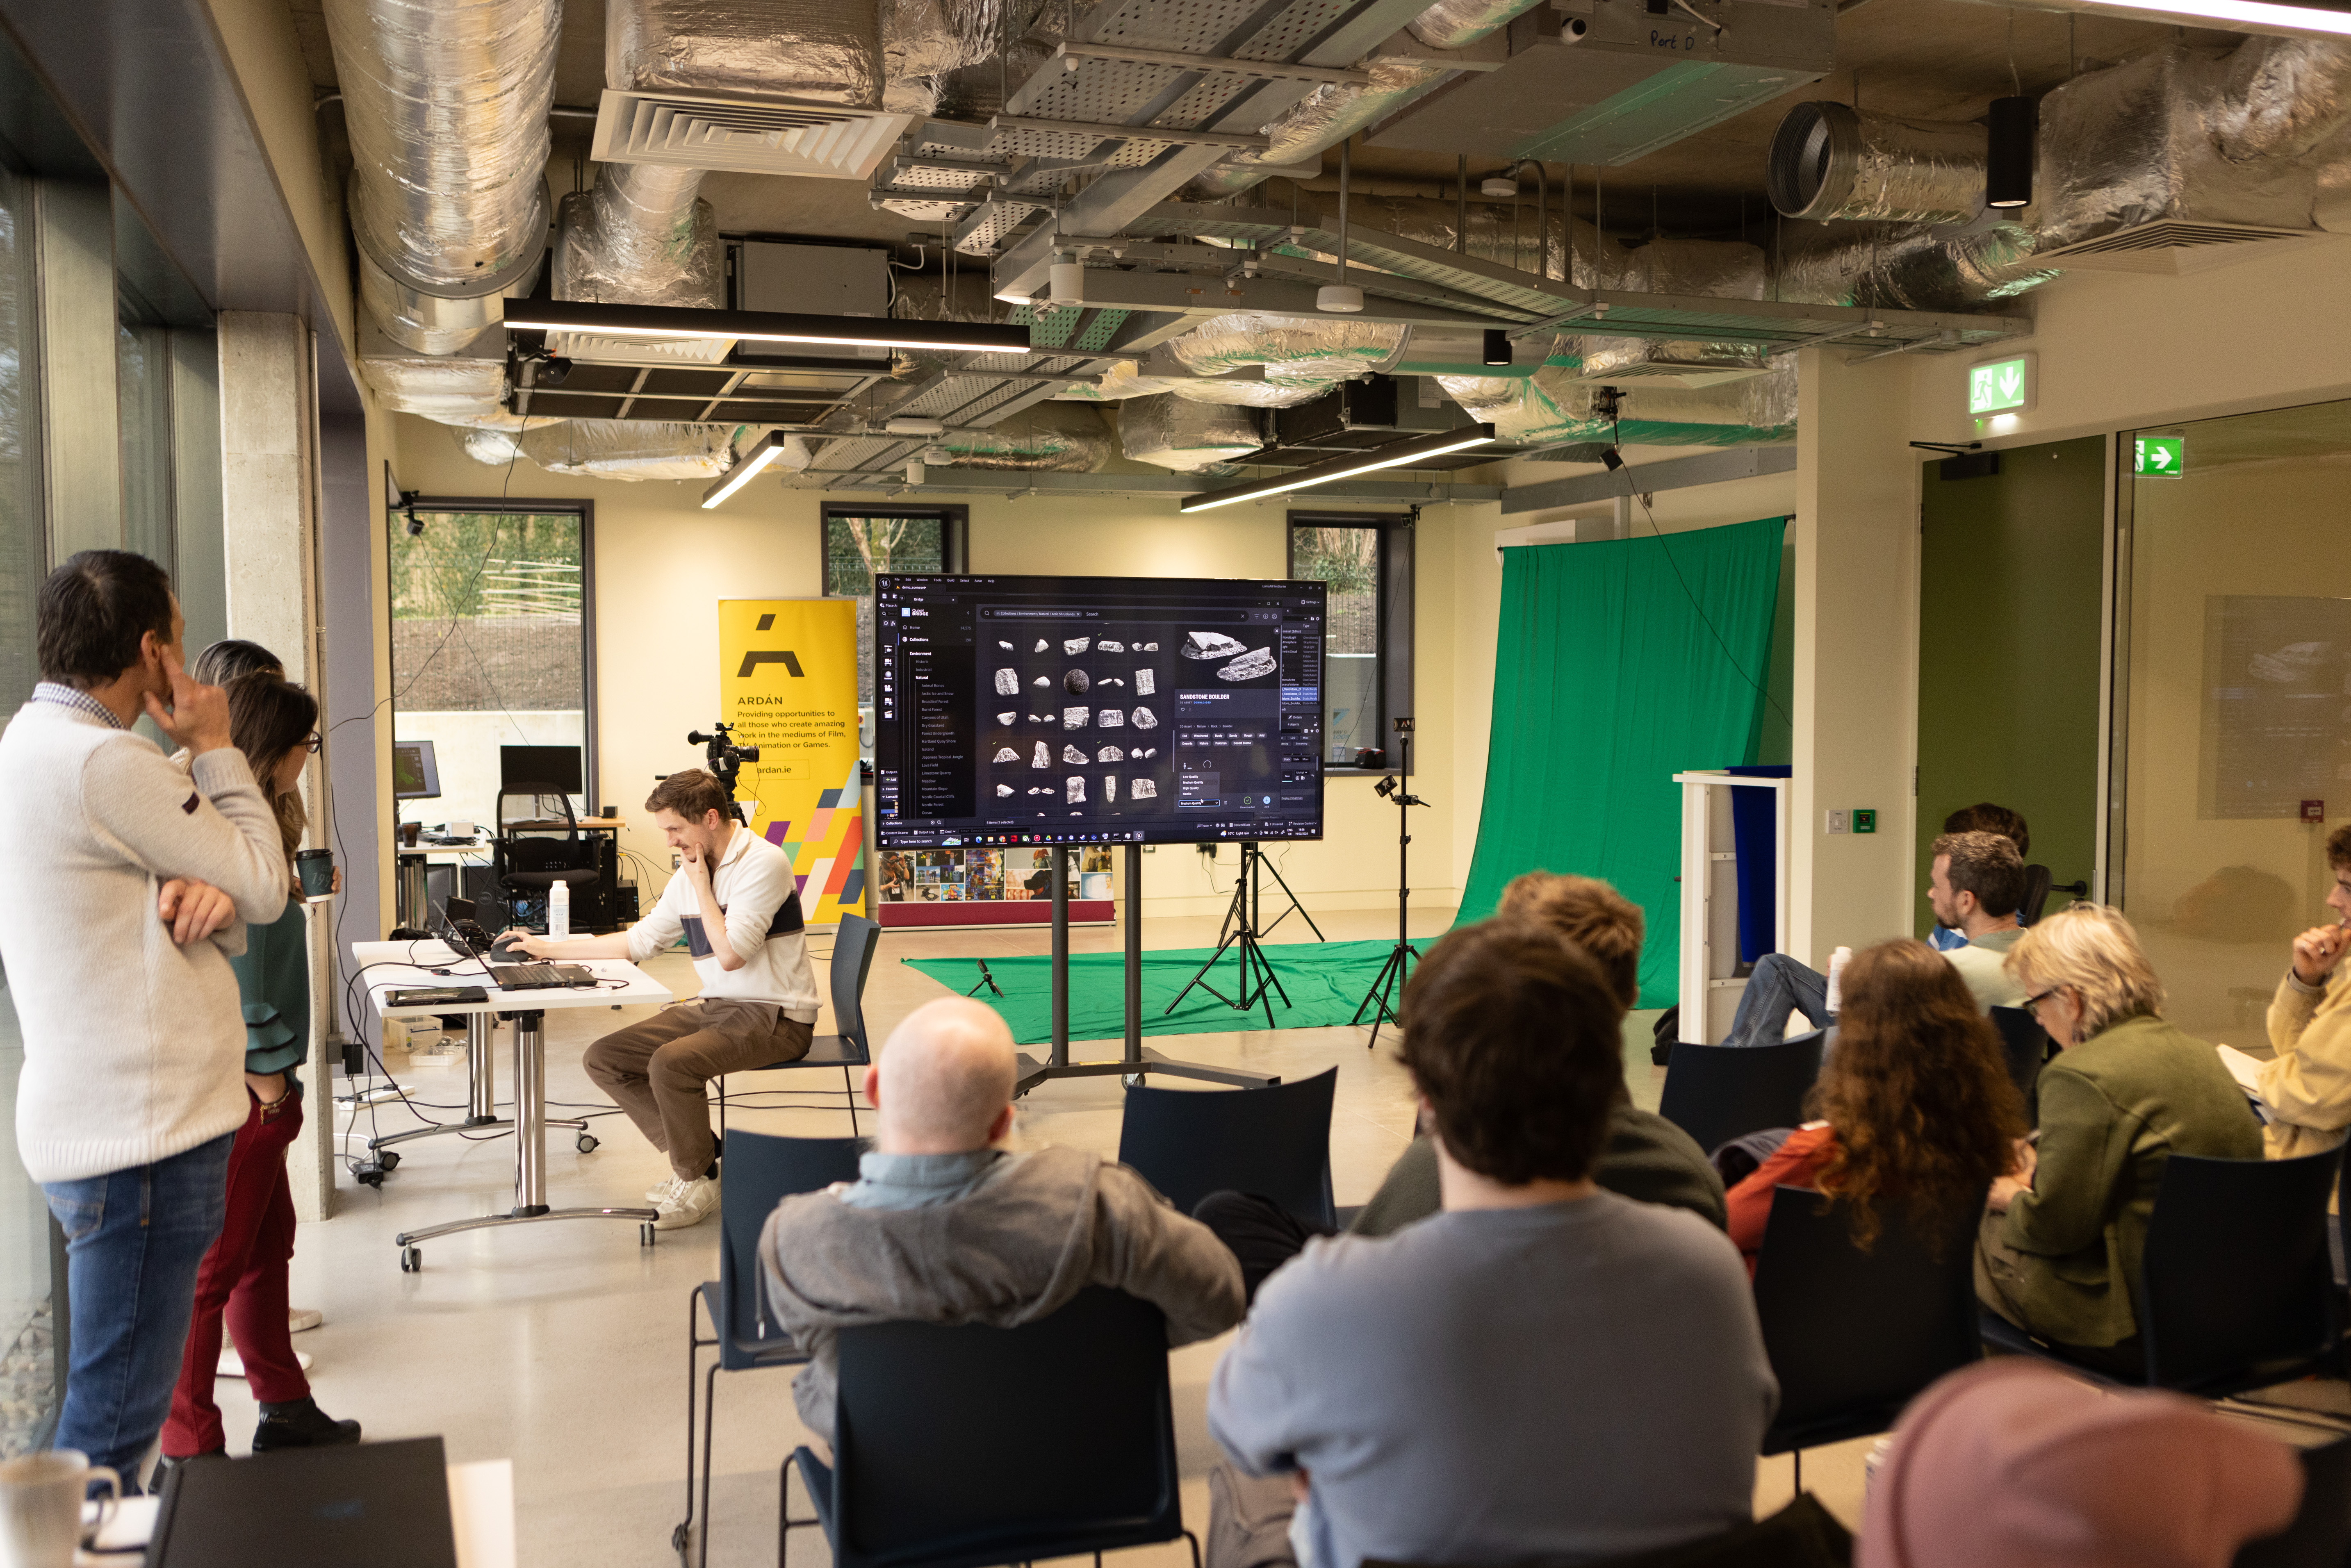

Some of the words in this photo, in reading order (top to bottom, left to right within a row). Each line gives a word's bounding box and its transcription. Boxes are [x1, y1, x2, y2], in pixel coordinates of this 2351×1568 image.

[1651, 30, 1677, 49] Port
[1686, 36, 1694, 50] D
[738, 694, 782, 704] ARDÁN
